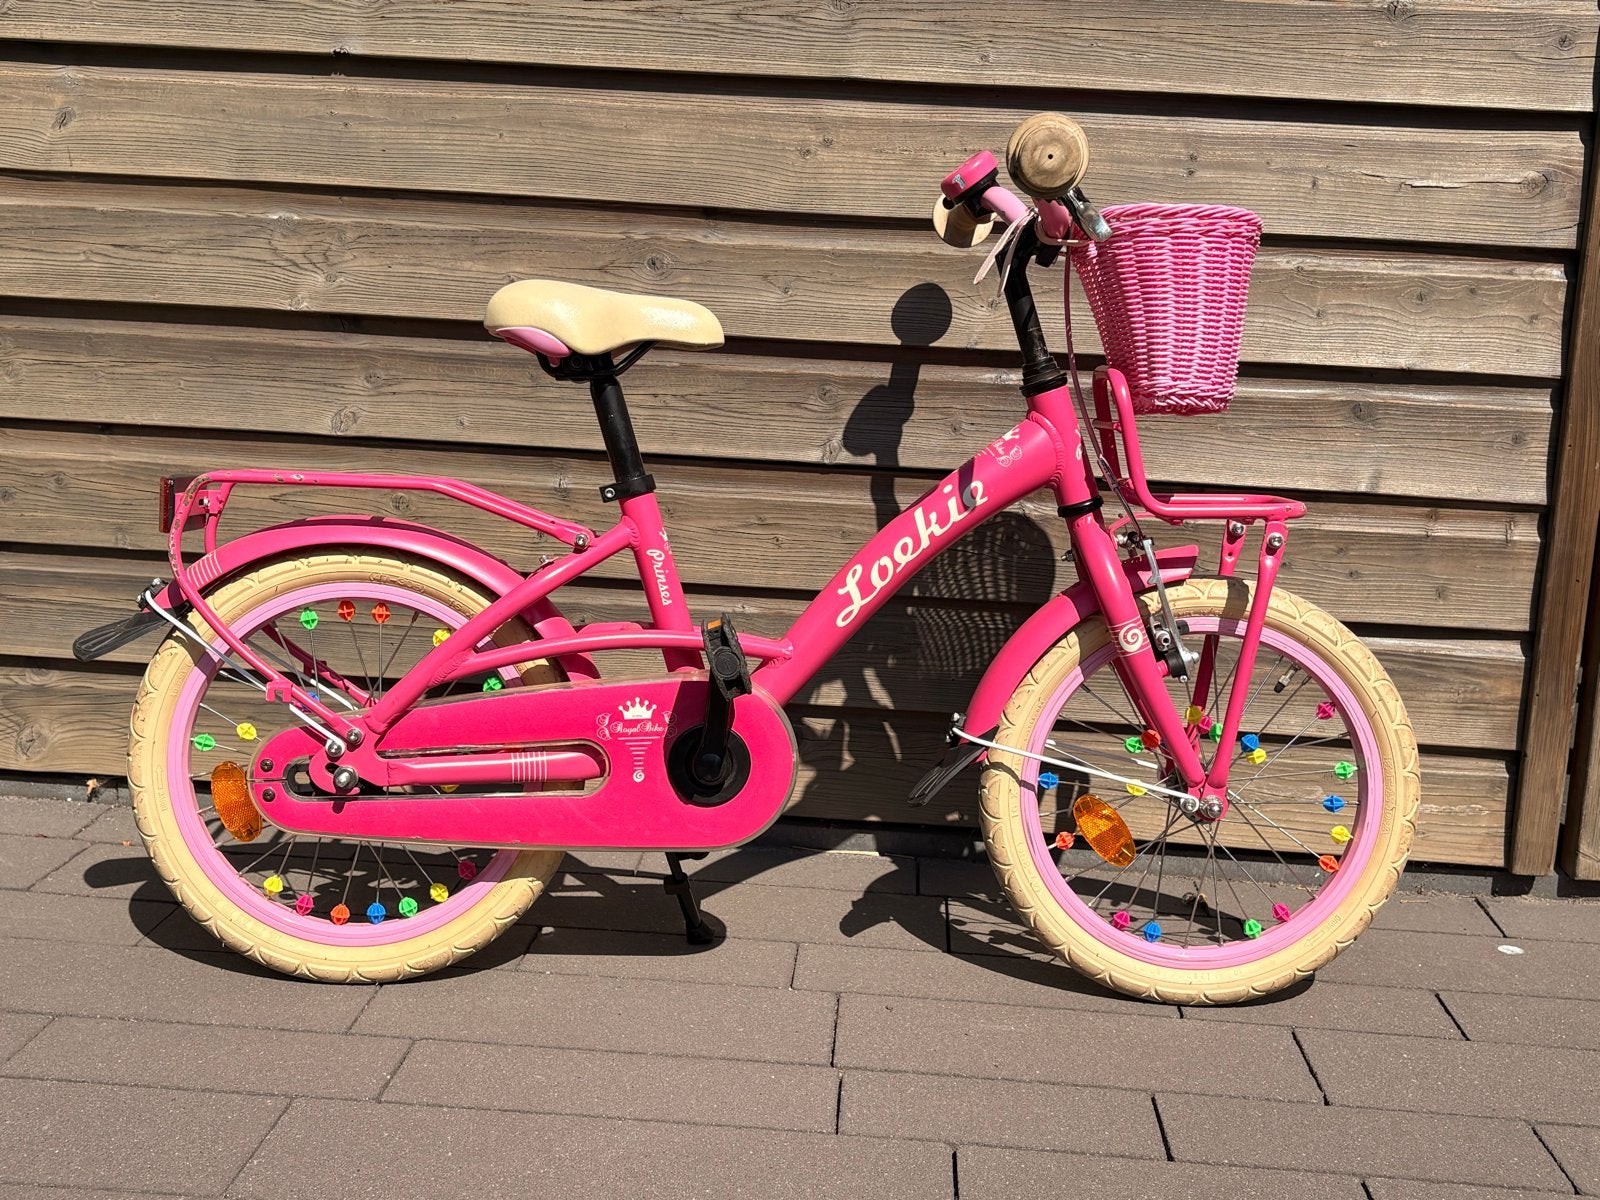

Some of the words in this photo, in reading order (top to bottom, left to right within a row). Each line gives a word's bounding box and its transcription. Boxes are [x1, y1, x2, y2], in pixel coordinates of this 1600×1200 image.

[646, 549, 673, 606] Prinses
[836, 480, 988, 628] Loekie
[610, 721, 640, 736] Royal
[640, 720, 664, 733] Bike
